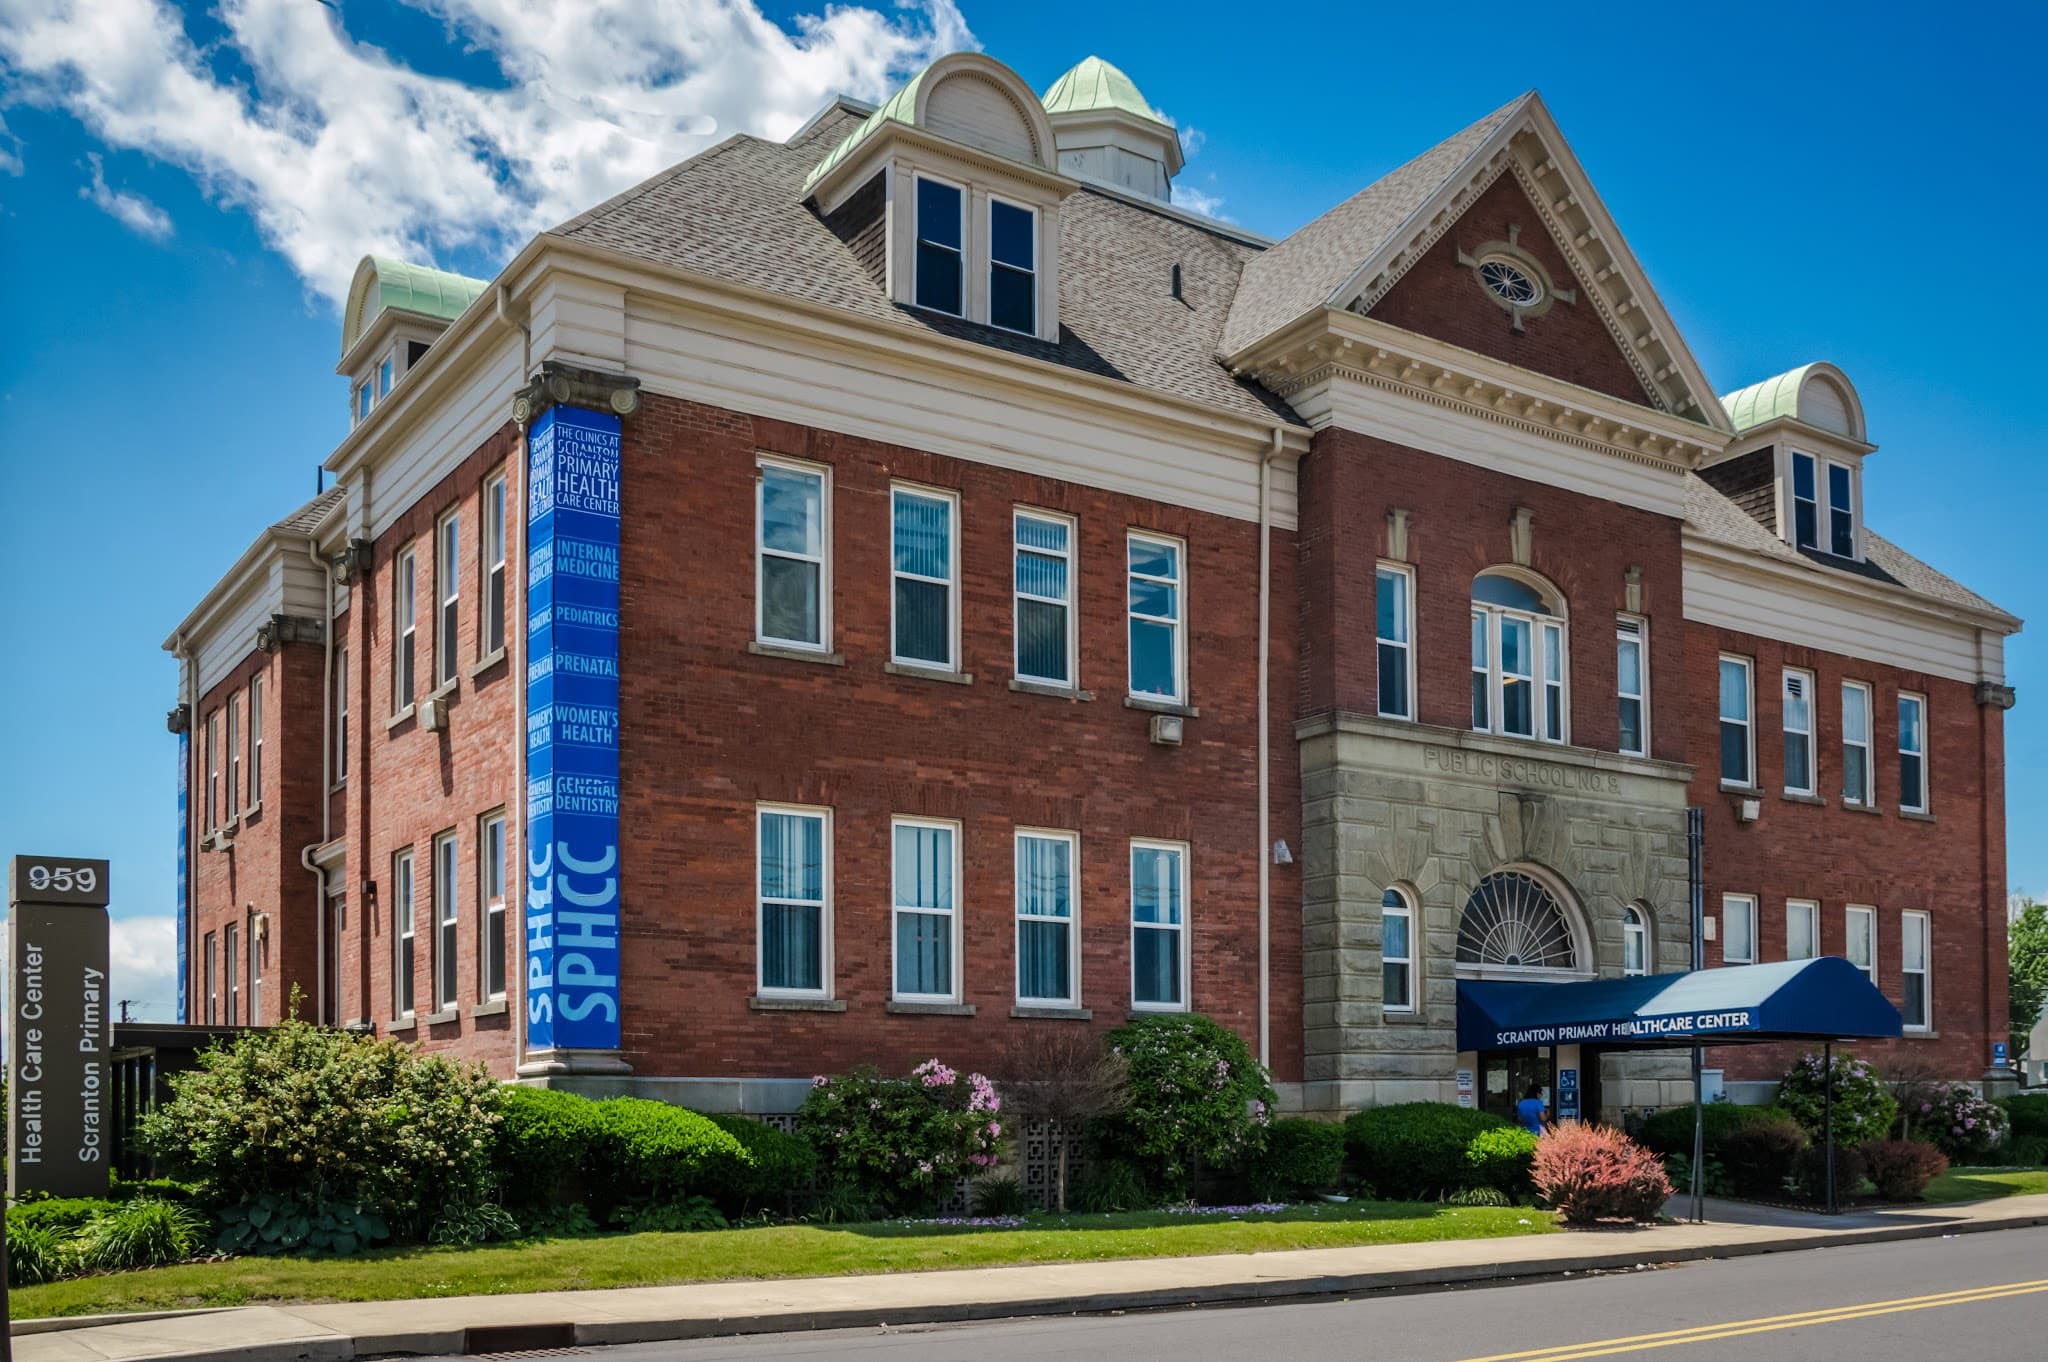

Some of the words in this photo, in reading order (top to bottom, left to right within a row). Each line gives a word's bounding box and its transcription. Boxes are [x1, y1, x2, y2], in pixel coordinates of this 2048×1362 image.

[557, 426, 573, 440] THE
[575, 429, 607, 446] CLINICS
[609, 436, 619, 448] AT
[558, 455, 619, 480] PRIMARY
[557, 472, 619, 501] HEALTH
[556, 492, 581, 508] CARE
[583, 496, 620, 514] CENTER
[556, 539, 619, 564] INTERNAL
[556, 556, 619, 581] MEDICINE
[556, 606, 618, 627] PEDIATRICS
[556, 654, 619, 677] PRENATAL
[555, 705, 619, 728] WOMEN'S
[530, 725, 550, 749] HEALTH
[562, 724, 613, 744] HEALTH
[1424, 748, 1493, 777] PUBLIC
[1501, 759, 1576, 789] SCHOOL
[1577, 770, 1604, 793] NO.
[556, 776, 618, 798] GENERAL
[556, 794, 619, 815] DENTISTRY
[29, 865, 97, 893] 959
[527, 842, 553, 1025] SPHCC
[557, 840, 617, 1024] SPHCC
[21, 943, 43, 1020] Center
[79, 967, 105, 1052] Primary
[1497, 1028, 1555, 1045] SCRANTON
[1559, 1023, 1609, 1040] PRIMARY
[1612, 1016, 1694, 1036] HEALTHCARE
[1696, 1012, 1750, 1029] CENTER
[21, 1028, 43, 1082] Care
[79, 1061, 100, 1162] Scranton
[21, 1090, 42, 1163] Health
